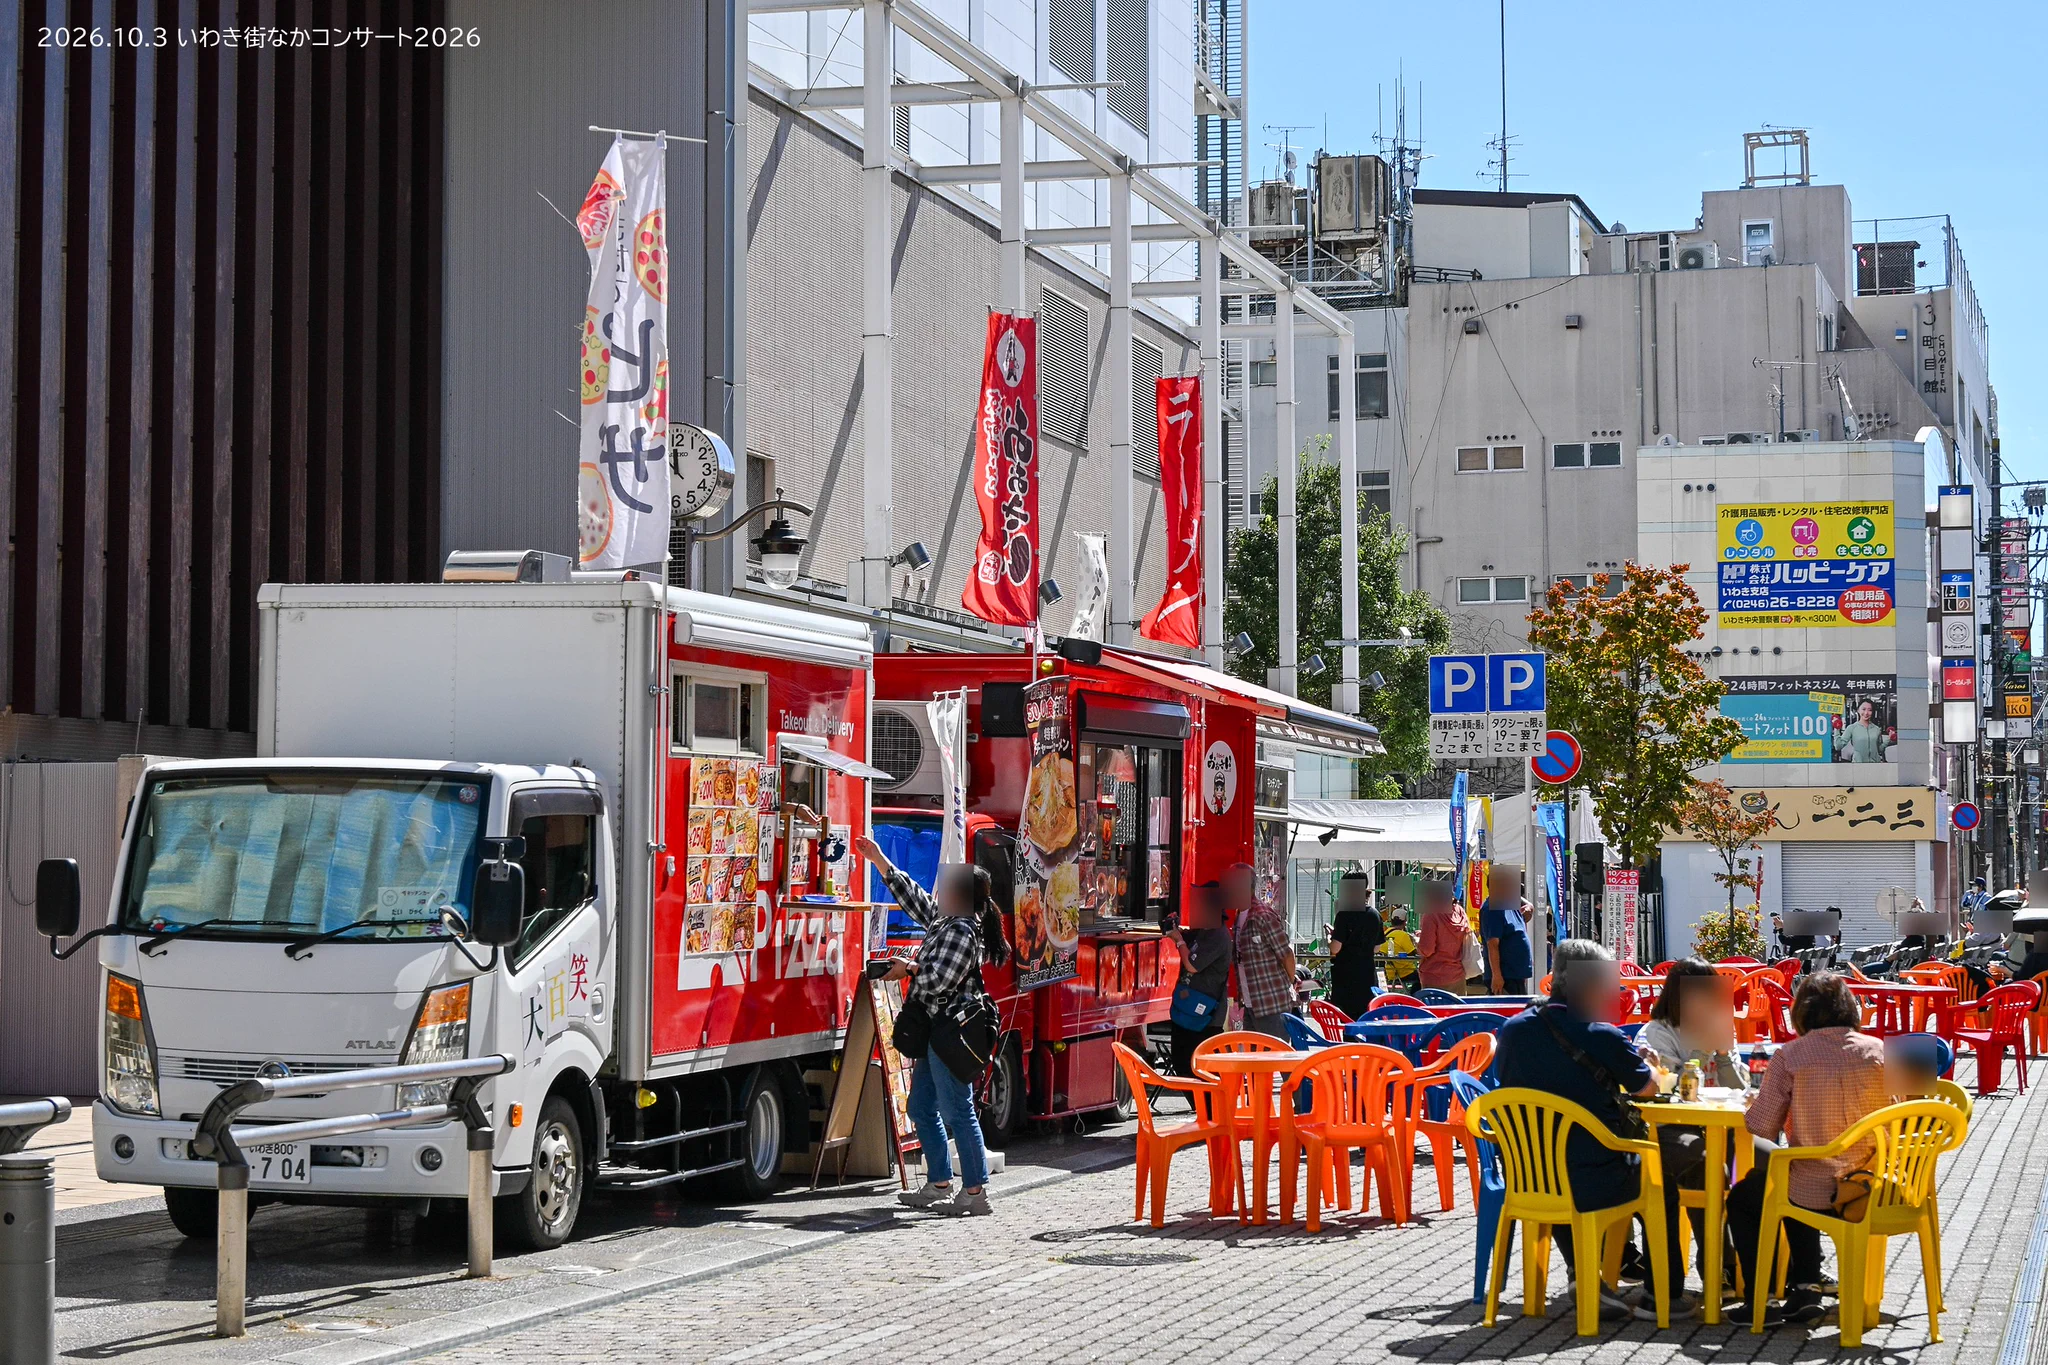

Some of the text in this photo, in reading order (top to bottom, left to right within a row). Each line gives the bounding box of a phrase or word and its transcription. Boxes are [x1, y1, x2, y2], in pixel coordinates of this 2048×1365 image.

[671, 433, 685, 447] 12
[698, 447, 708, 460] 2
[702, 463, 712, 476] 3
[697, 478, 708, 492] 4
[686, 490, 696, 504] 5
[1950, 487, 1962, 496] 3F
[671, 495, 681, 509] 6
[1721, 506, 1889, 519] 介護用品販売・レンタル・住宅改修専門店
[1725, 547, 1775, 559] レンタル
[1793, 546, 1818, 557] 販売
[1836, 545, 1887, 556] 住宅改修
[1749, 563, 1771, 574] 株式
[1771, 561, 1890, 585] ハッピーケア
[1749, 574, 1771, 585] 会社
[1951, 574, 1962, 582] 2F
[1722, 587, 1770, 596] いわき支店
[1844, 590, 1885, 601] 介護用品
[1445, 662, 1476, 708] P
[1503, 659, 1535, 706] P
[1730, 679, 1841, 691] 24時間フィットネスジム
[779, 708, 813, 733] Takeout
[821, 717, 855, 743] Delivery
[1491, 718, 1544, 729] タクシーに限る
[1435, 743, 1483, 754] ここまで
[1493, 742, 1542, 753] ここまで
[1812, 799, 1926, 831] 一二三
[345, 1039, 396, 1050] ATLAS
